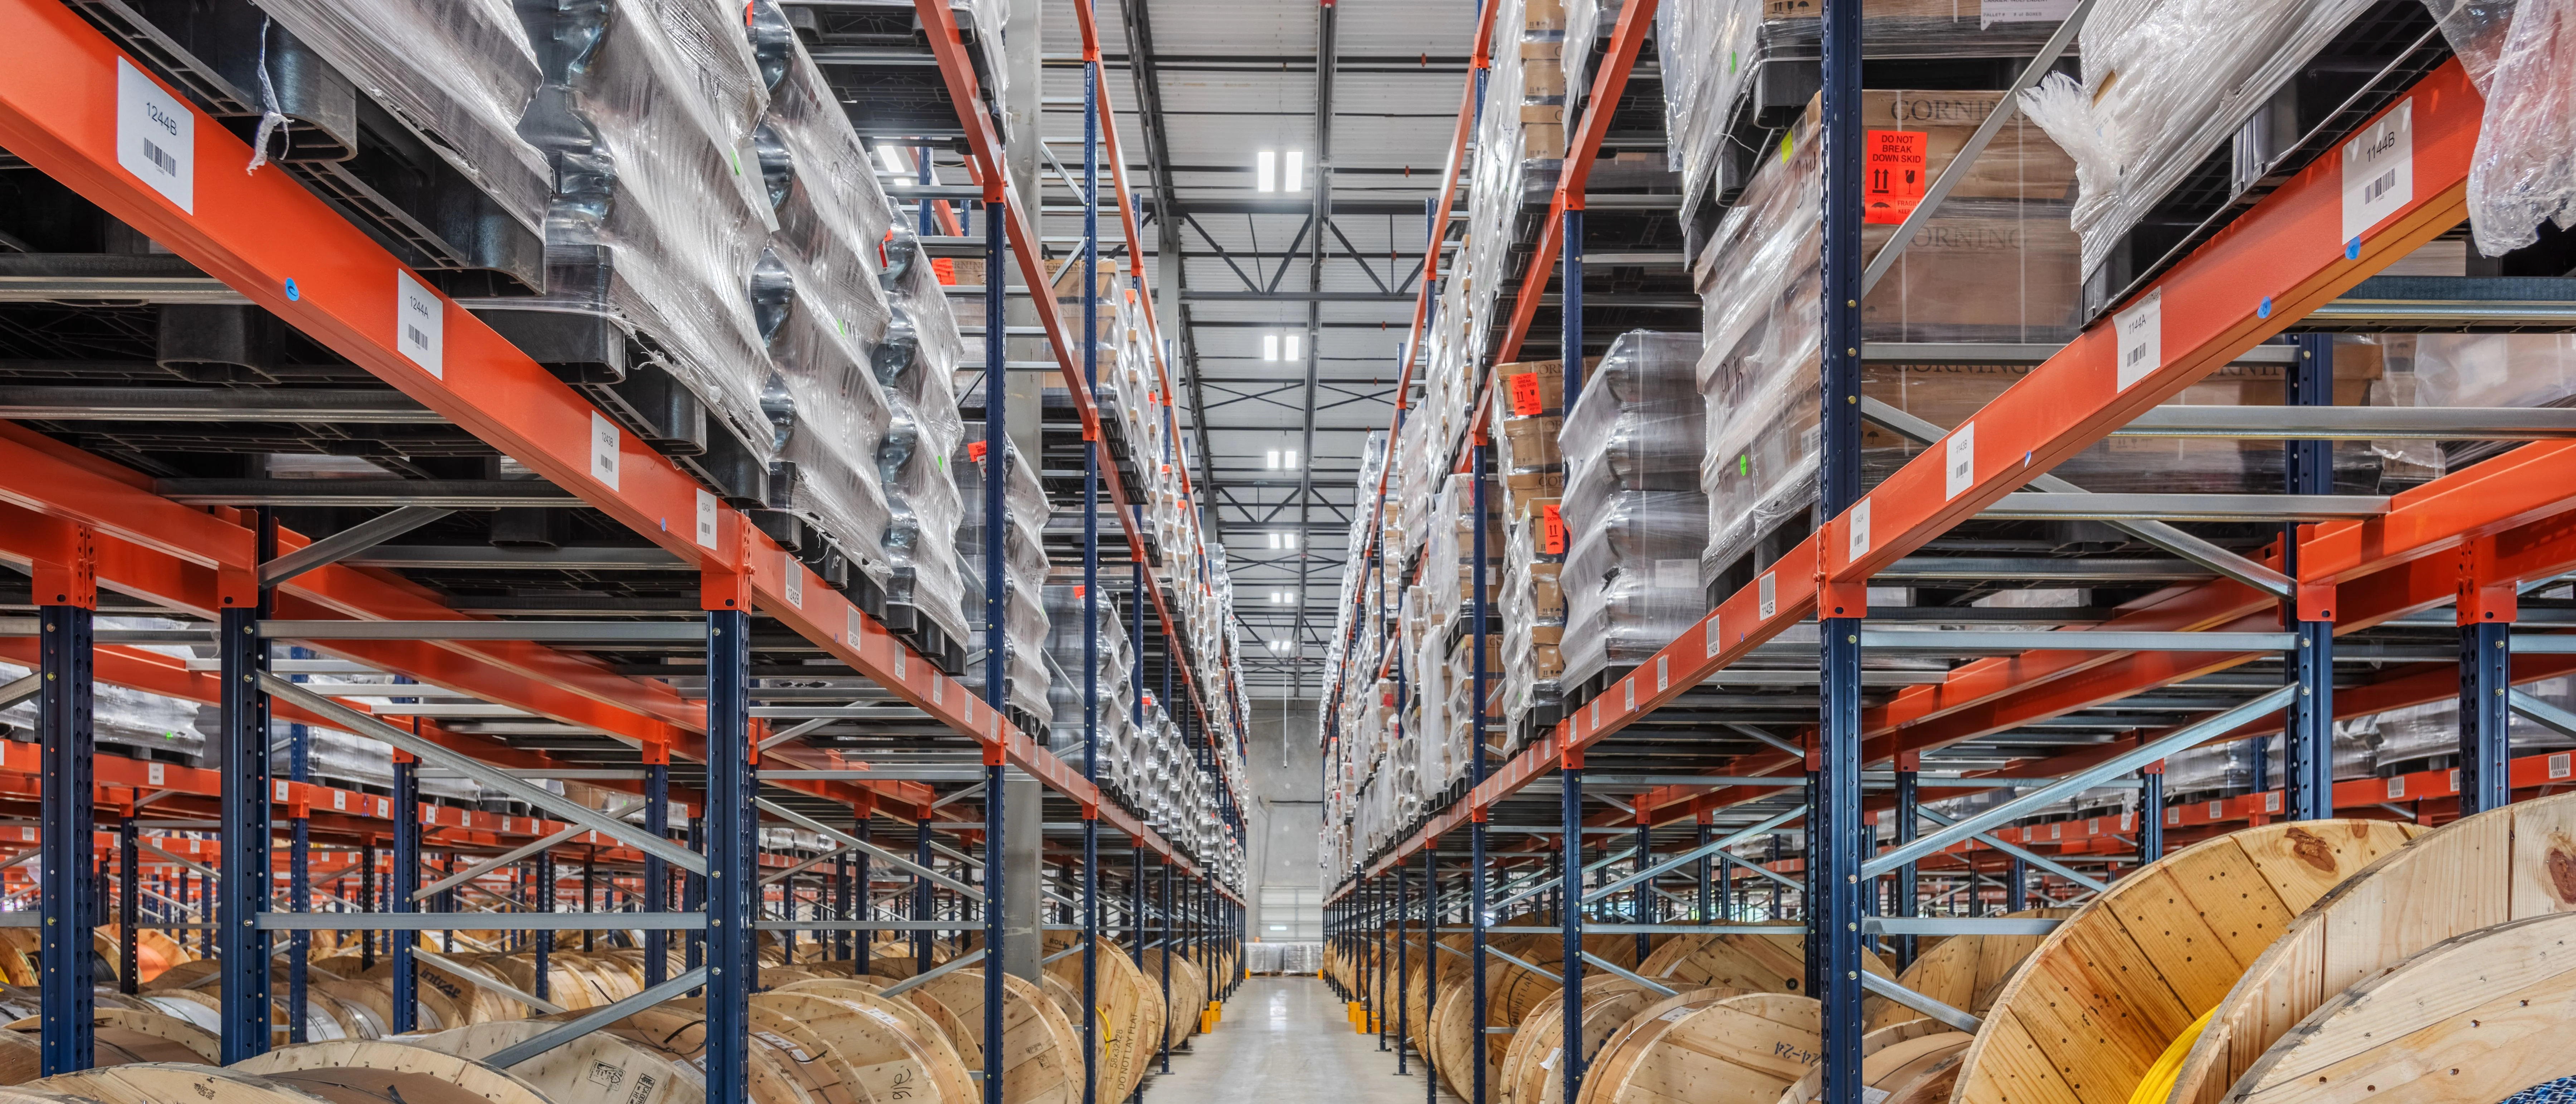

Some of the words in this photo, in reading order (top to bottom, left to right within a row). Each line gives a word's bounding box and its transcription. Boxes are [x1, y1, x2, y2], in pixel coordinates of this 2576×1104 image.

[147, 102, 176, 136] 1244B
[1882, 145, 1912, 153] BREAK
[2367, 131, 2395, 162] 1144B
[1873, 154, 1898, 162] DOWN
[1911, 225, 2028, 250] ORNING
[410, 296, 428, 319] 1244A
[2129, 314, 2146, 334] 1144A
[602, 432, 613, 447] 1243B
[1956, 439, 1967, 454] 1143B
[702, 502, 710, 513] 1243A
[788, 587, 799, 605] 1242B
[1762, 602, 1773, 617] 1142B
[850, 634, 858, 648] 1242A
[1708, 642, 1718, 656] 1142A
[1127, 1012, 1138, 1035] FLAT
[1125, 1038, 1135, 1053] LAY
[1120, 1054, 1130, 1074] NOT
[1117, 1078, 1127, 1090] DO
[206, 1089, 216, 1100] 804
[632, 1091, 640, 1099] HT
